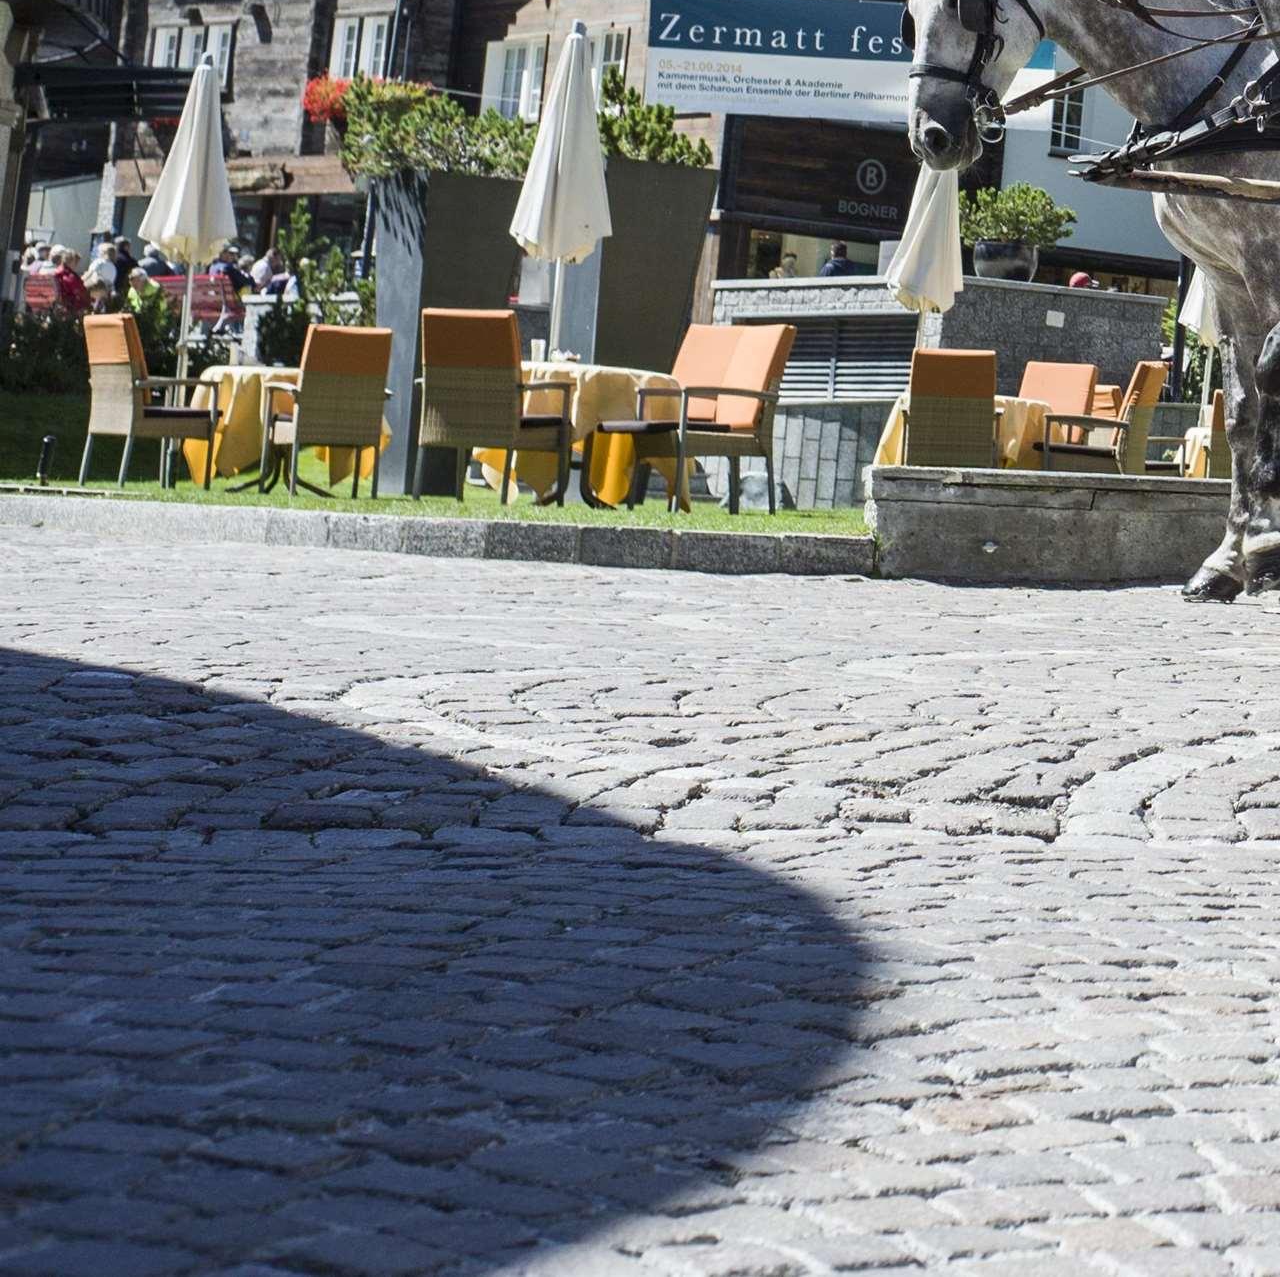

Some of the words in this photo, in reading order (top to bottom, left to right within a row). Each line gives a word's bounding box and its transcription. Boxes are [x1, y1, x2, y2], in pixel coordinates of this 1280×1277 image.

[658, 13, 825, 51] Zermatt
[850, 26, 903, 54] fes
[658, 70, 730, 84] Kammermusik,
[733, 75, 784, 87] Orchester
[795, 79, 843, 89] Akademie
[657, 81, 673, 91] mit
[675, 82, 696, 92] dem
[699, 83, 744, 95] Scharoun
[746, 85, 793, 97] Ensemble
[795, 87, 810, 97] der
[813, 89, 851, 100] Berliner
[838, 199, 898, 219] BOGNER
